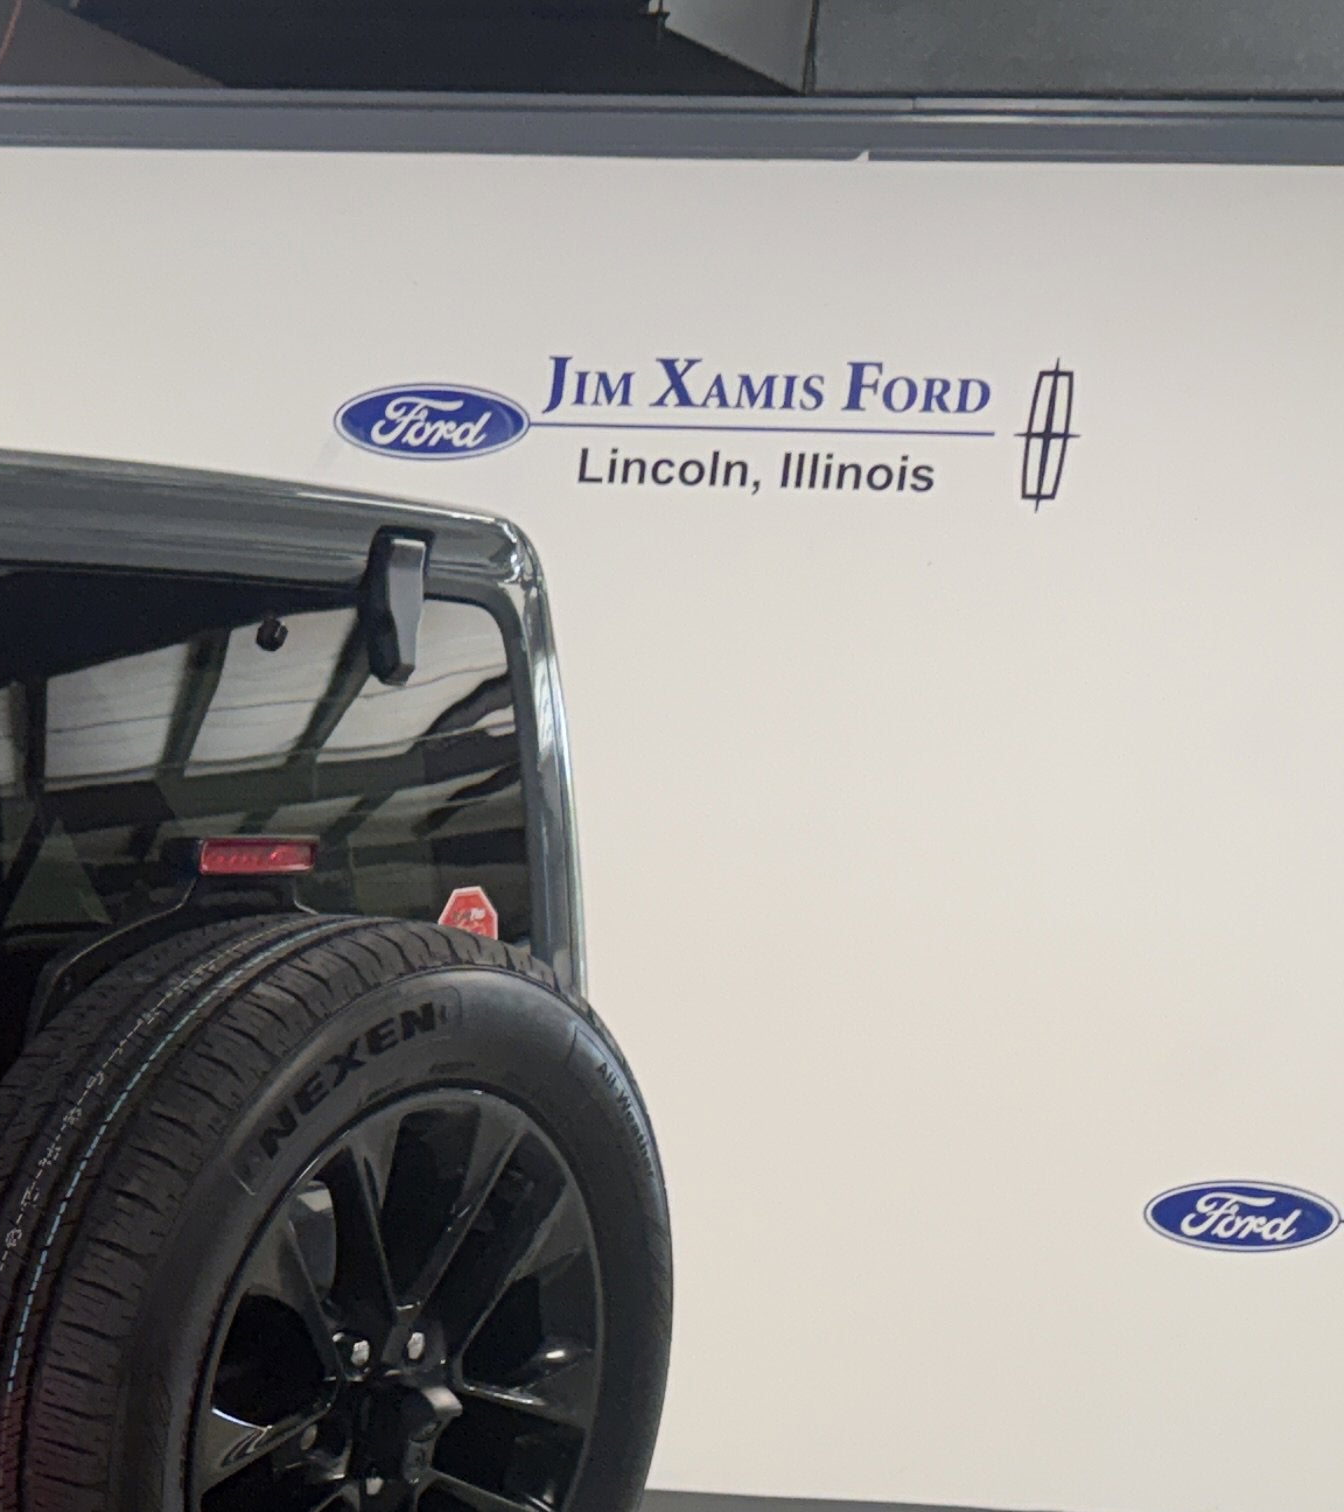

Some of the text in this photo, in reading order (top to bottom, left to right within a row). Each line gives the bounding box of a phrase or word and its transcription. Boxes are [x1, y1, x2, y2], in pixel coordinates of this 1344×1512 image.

[372, 398, 486, 447] Ford
[578, 448, 935, 494] Lincoln, Illinois
[255, 1001, 437, 1160] NEXEN
[1181, 1191, 1302, 1241] Ford
